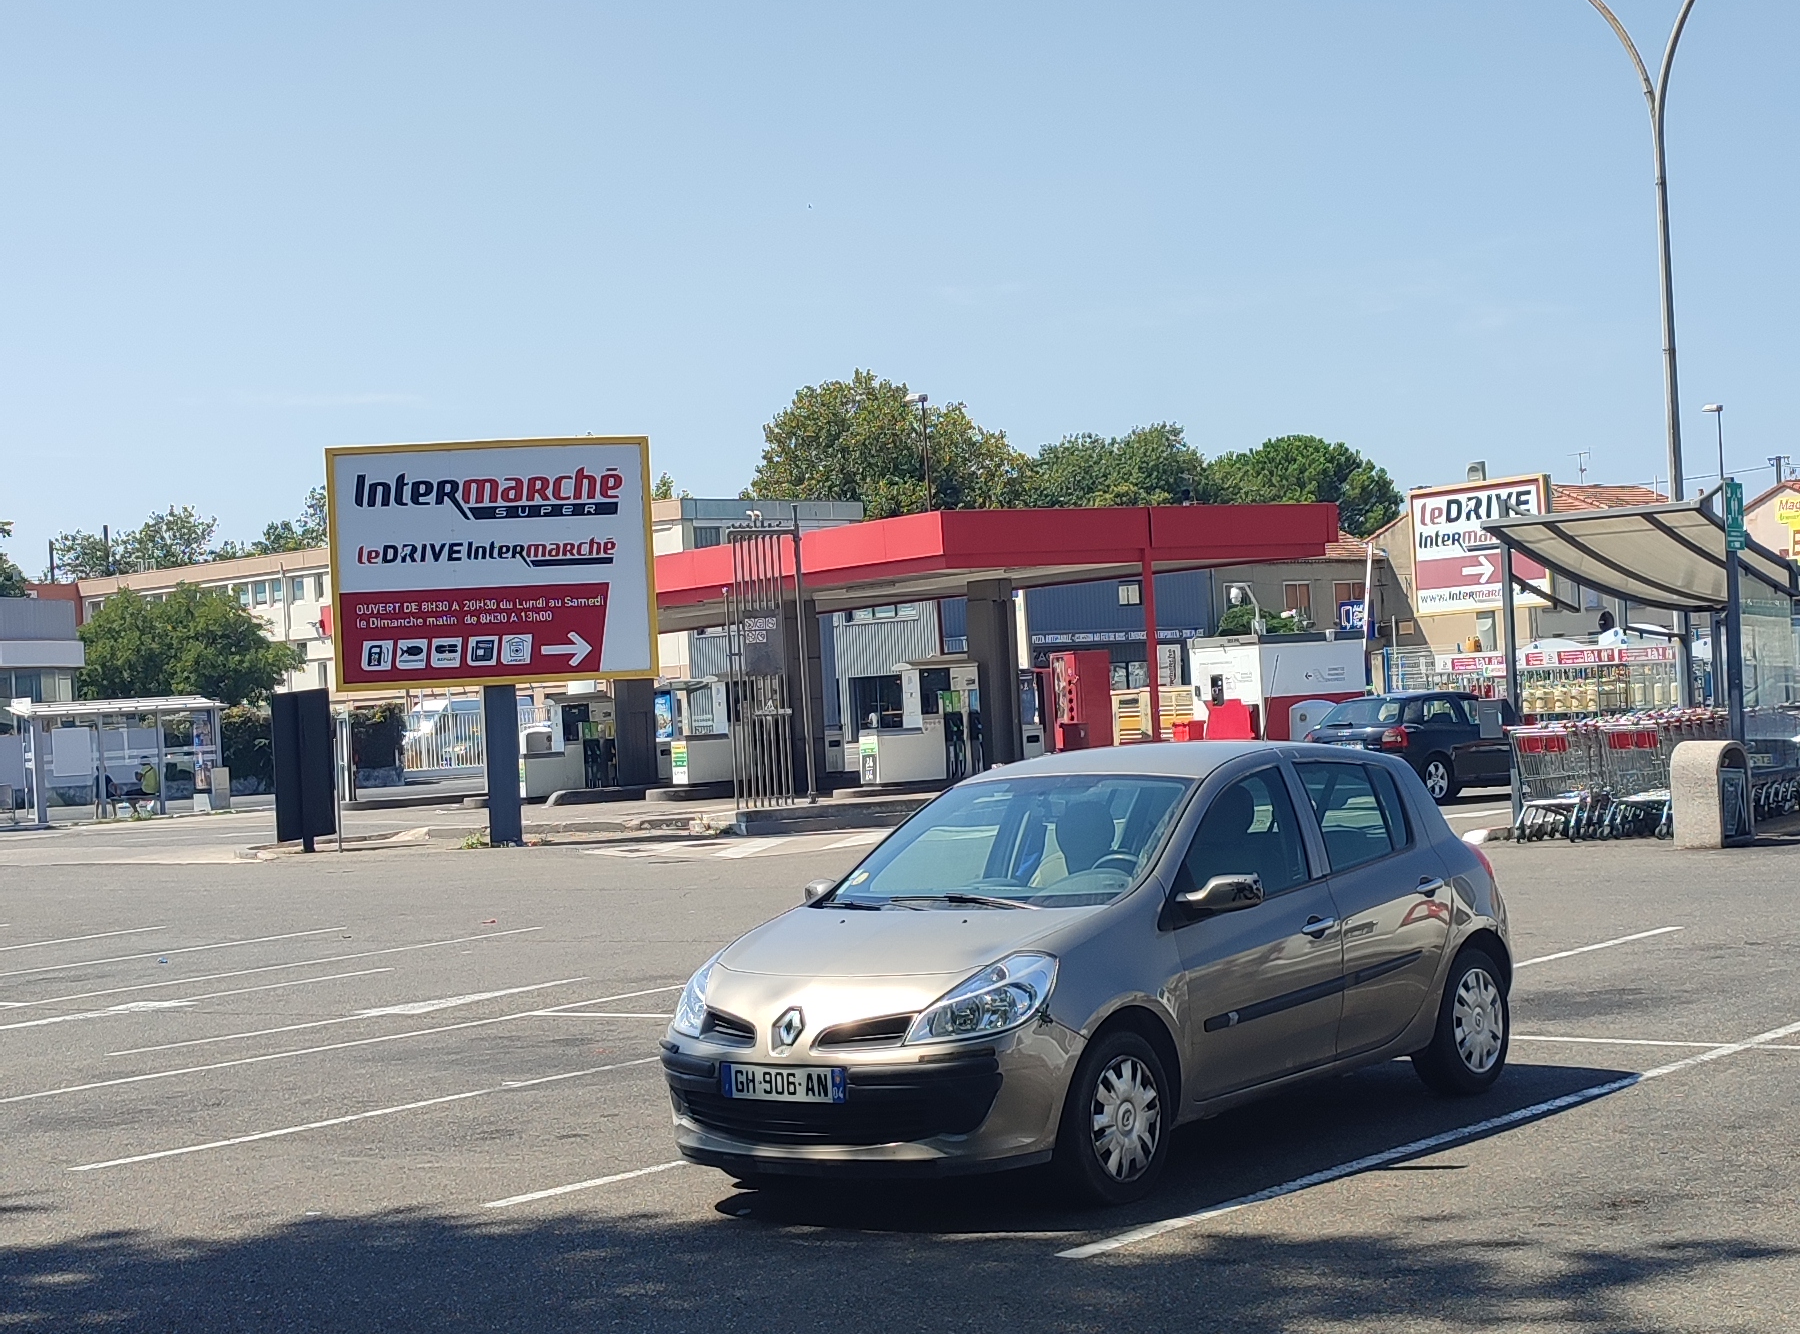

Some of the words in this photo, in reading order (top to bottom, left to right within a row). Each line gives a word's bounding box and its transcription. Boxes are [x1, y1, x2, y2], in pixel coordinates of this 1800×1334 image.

[355, 466, 623, 520] Intermarché
[495, 504, 596, 517] SUPER
[466, 535, 616, 568] Intermarché
[1418, 530, 1501, 553] Interma
[356, 602, 401, 615] OUVERT
[403, 602, 420, 613] DE
[421, 600, 450, 612] 8H30
[451, 600, 460, 610] A
[462, 597, 498, 611] 20H30
[499, 598, 514, 609] du
[516, 596, 547, 609] Lundi
[548, 597, 562, 607] au
[564, 594, 605, 607] Samedi
[356, 616, 367, 628] le
[369, 616, 424, 629] Dimanche
[426, 614, 458, 626] matin
[464, 614, 478, 625] de
[479, 612, 508, 623] 8H30
[509, 612, 519, 623] A
